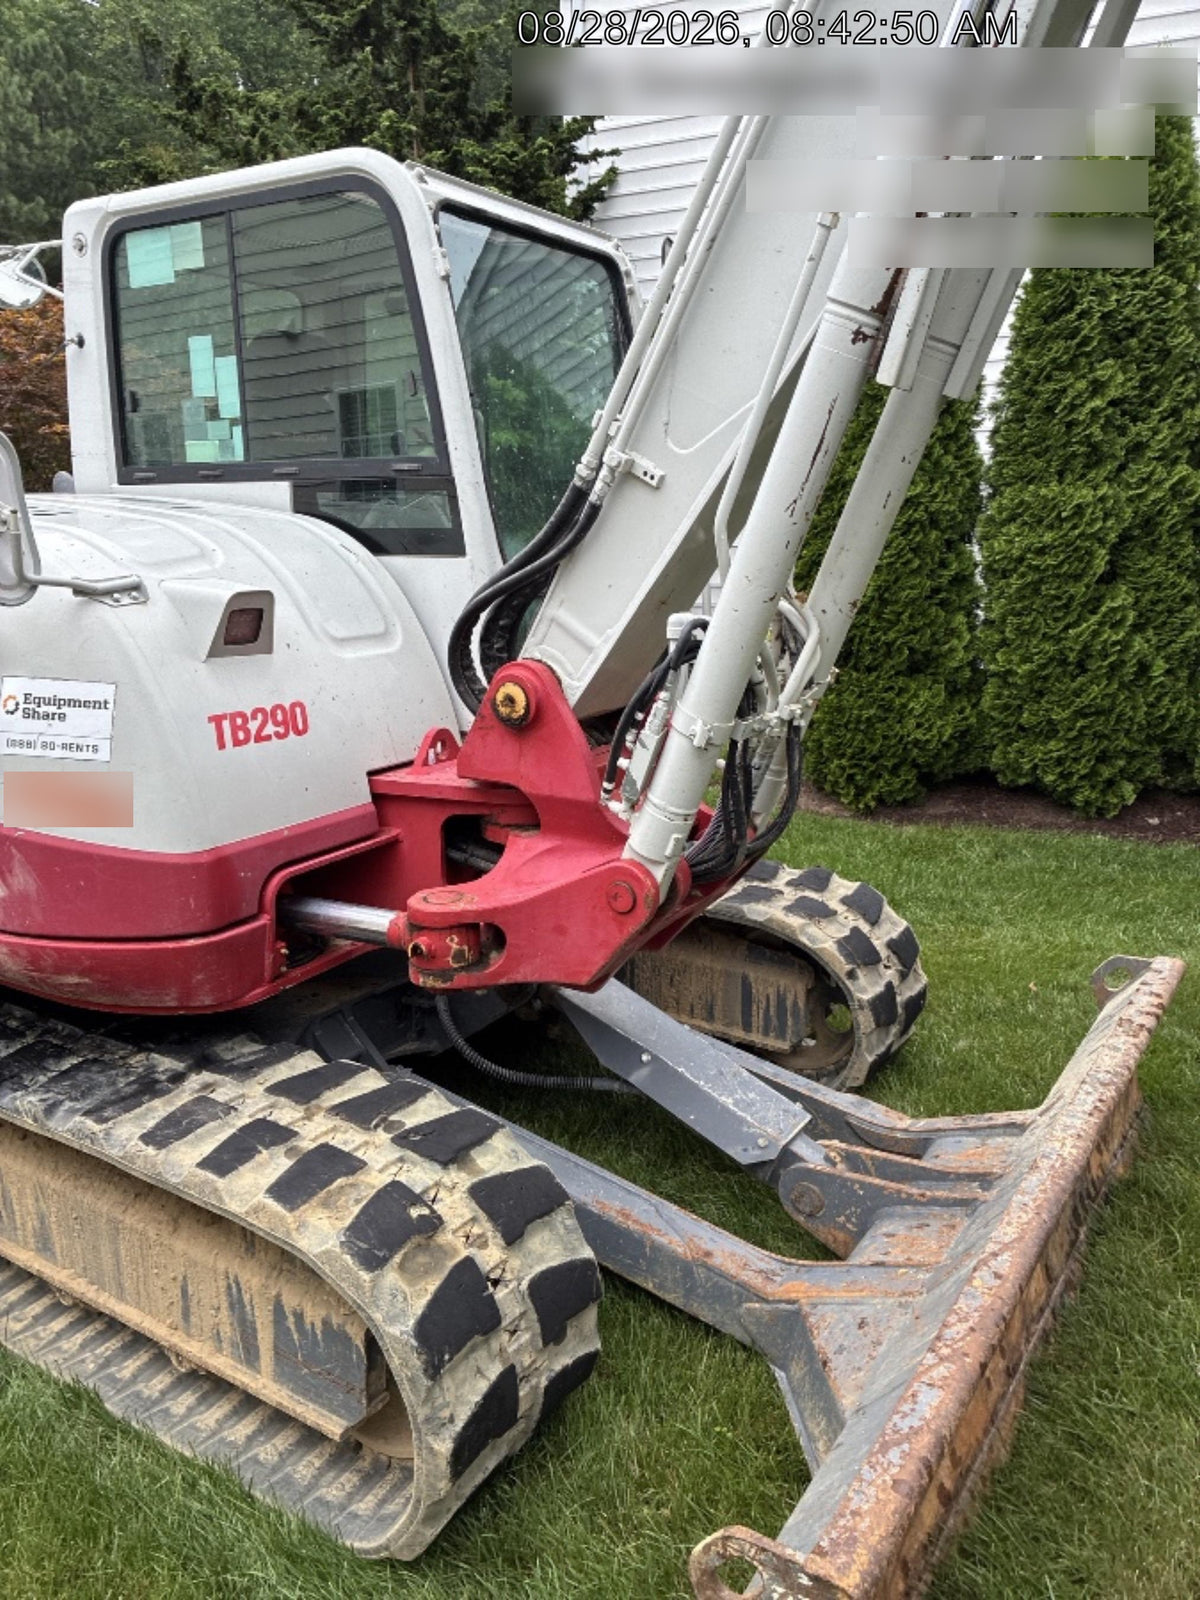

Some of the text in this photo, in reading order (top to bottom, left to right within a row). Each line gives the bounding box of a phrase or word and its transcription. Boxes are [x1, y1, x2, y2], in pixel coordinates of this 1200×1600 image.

[22, 692, 110, 710] Equipment
[22, 707, 67, 722] Share
[207, 700, 309, 751] TB290
[40, 740, 99, 755] 80-RENTS
